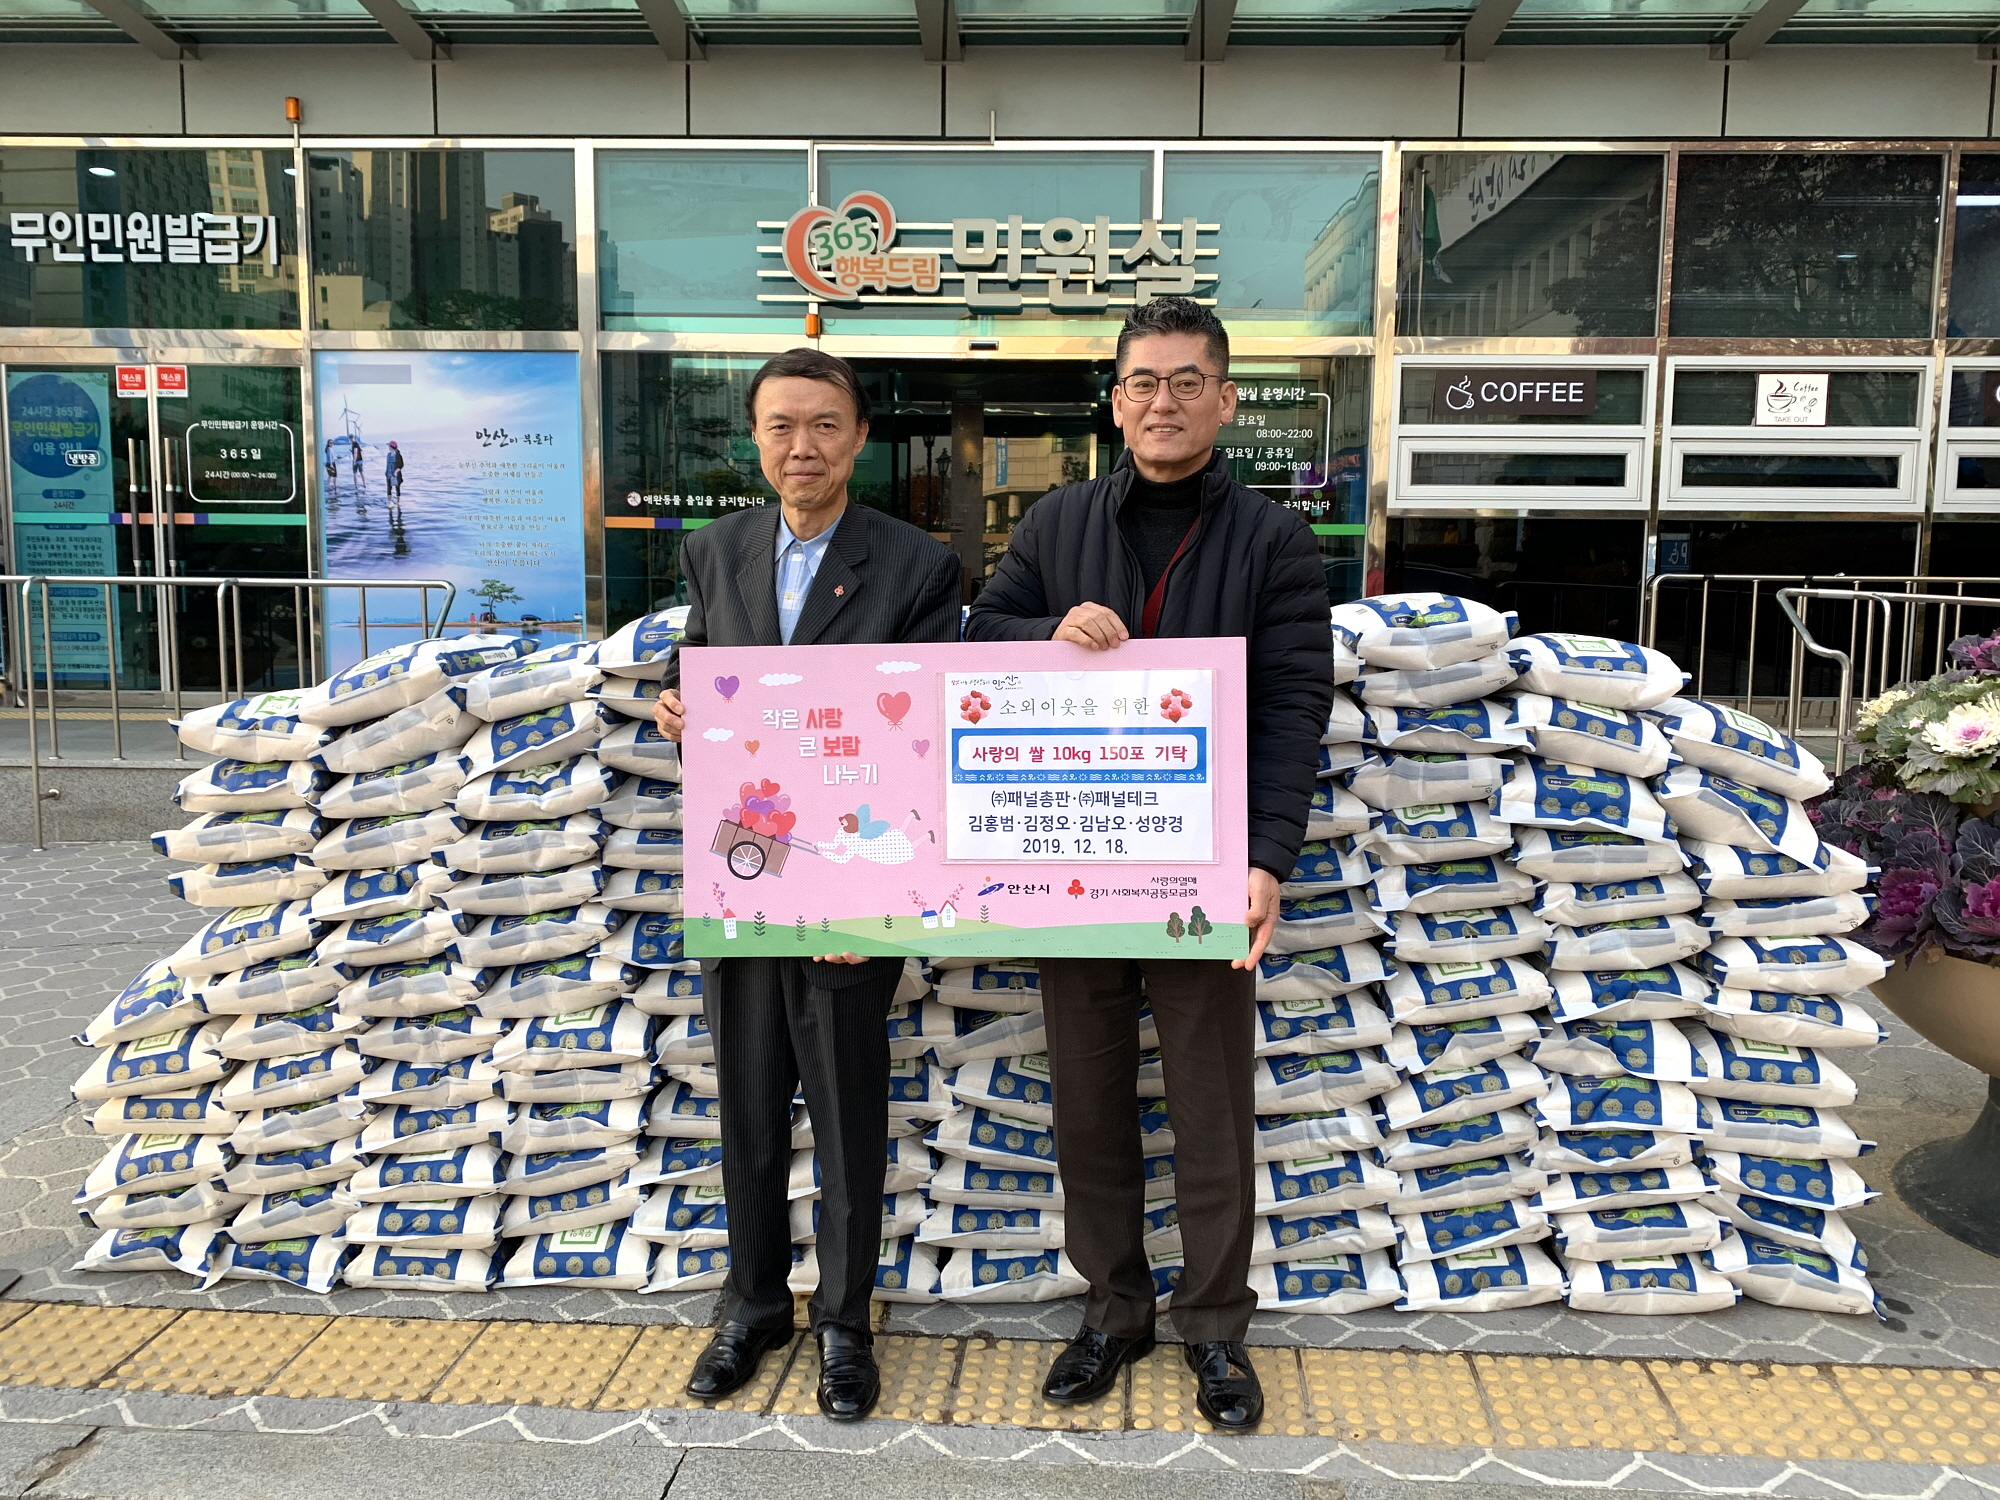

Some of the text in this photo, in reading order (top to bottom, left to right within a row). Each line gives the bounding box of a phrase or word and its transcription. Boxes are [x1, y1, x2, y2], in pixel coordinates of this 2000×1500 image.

[10, 211, 279, 265] 무인민원발급기
[814, 221, 872, 261] 365
[952, 215, 1197, 308] 민원실
[835, 256, 936, 288] 행복드림
[1480, 381, 1585, 403] COFFEE
[1793, 381, 1819, 392] Coffee
[1237, 387, 1306, 401] 원실 운영시간
[21, 405, 52, 417] 24시간
[201, 420, 278, 430] 무인민원발급기 운영시간
[1237, 414, 1266, 426] 금요일
[10, 421, 99, 438] 무인민원발급기
[1256, 429, 1313, 439] 08:00~22:00
[475, 427, 554, 448] 안산이 부른다
[33, 442, 56, 456] 이용
[1225, 447, 1254, 459] 일요일
[1265, 447, 1294, 459] 공휴일
[68, 453, 97, 465] 냉방중
[1255, 461, 1312, 471] 09:00~18:00
[204, 470, 230, 479] 24시간
[53, 501, 75, 510] 24시간
[643, 494, 766, 507] 애완동물 출입을 금지합니다
[999, 697, 1150, 716] 소외이웃을 위한
[762, 708, 843, 730] 작은 사랑
[798, 736, 861, 758] 큰 보람
[972, 746, 1188, 764] 사랑의 쌀 10kg 150포 기탁
[822, 763, 879, 786] 나누기
[1022, 839, 1128, 855] 2019. 12. 18.
[1150, 876, 1197, 886] 사랑의열매
[1007, 883, 1050, 895] 안산시
[1089, 888, 1198, 899] 경기 사회복지공동모금회
